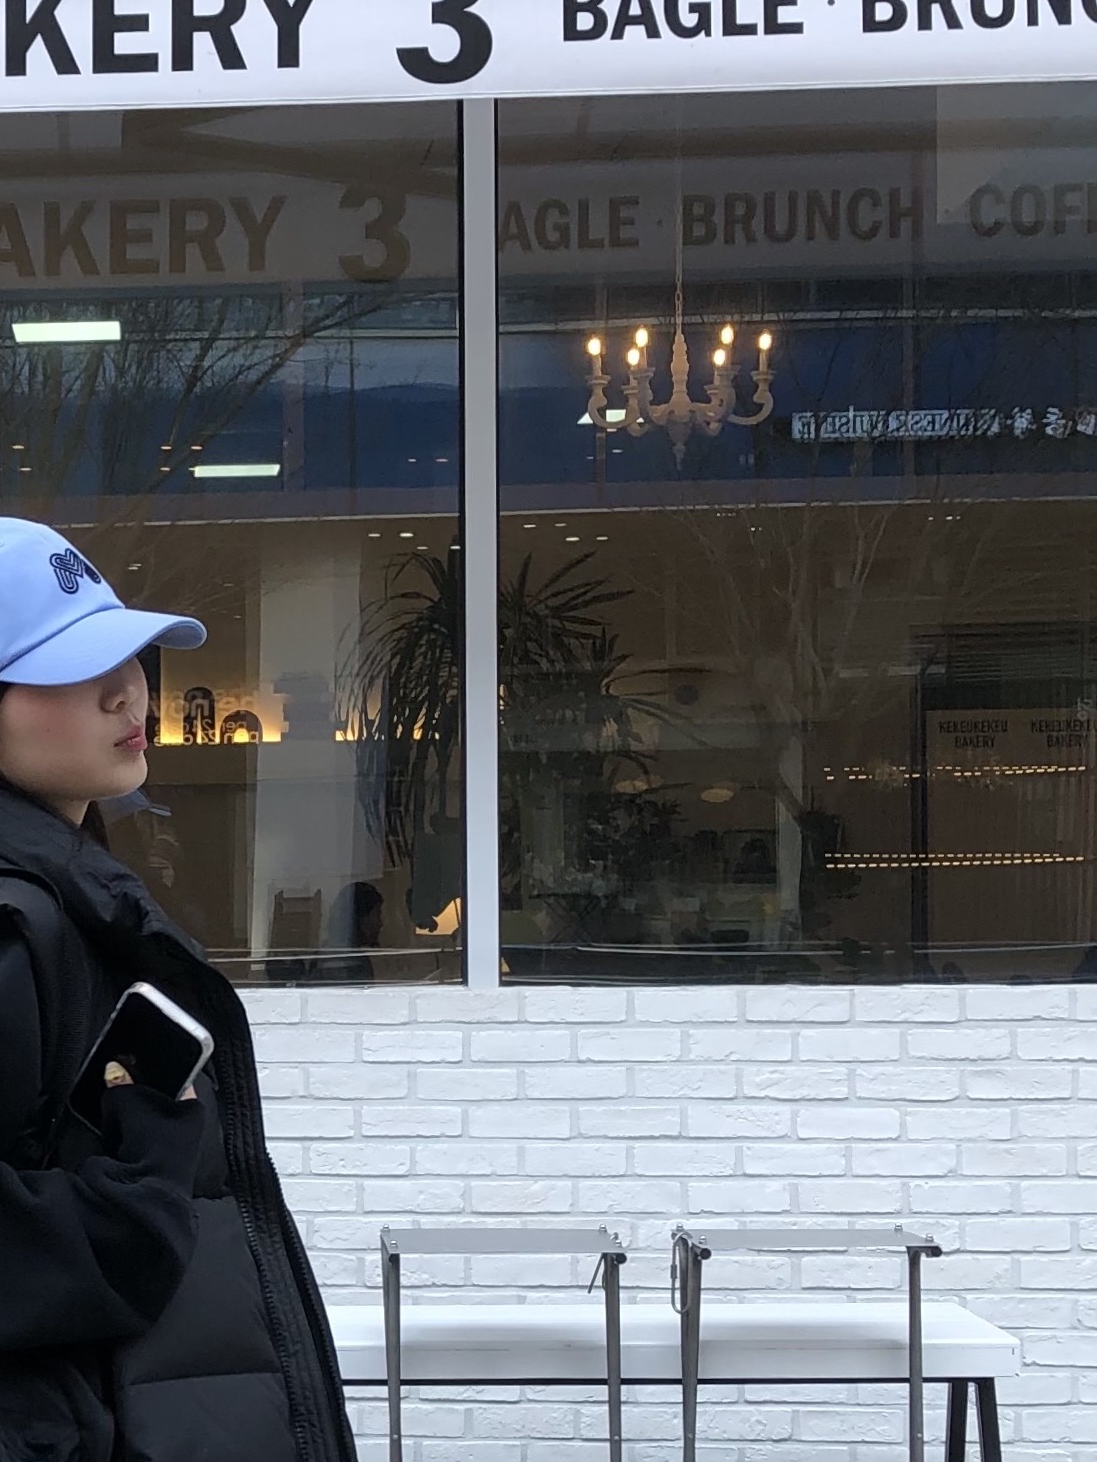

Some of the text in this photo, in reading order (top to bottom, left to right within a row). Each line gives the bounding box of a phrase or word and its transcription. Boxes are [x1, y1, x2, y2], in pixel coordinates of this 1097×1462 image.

[396, 0, 493, 84] 3
[338, 188, 411, 283] 3
[498, 182, 1097, 253] AGLE BRUNCH COF
